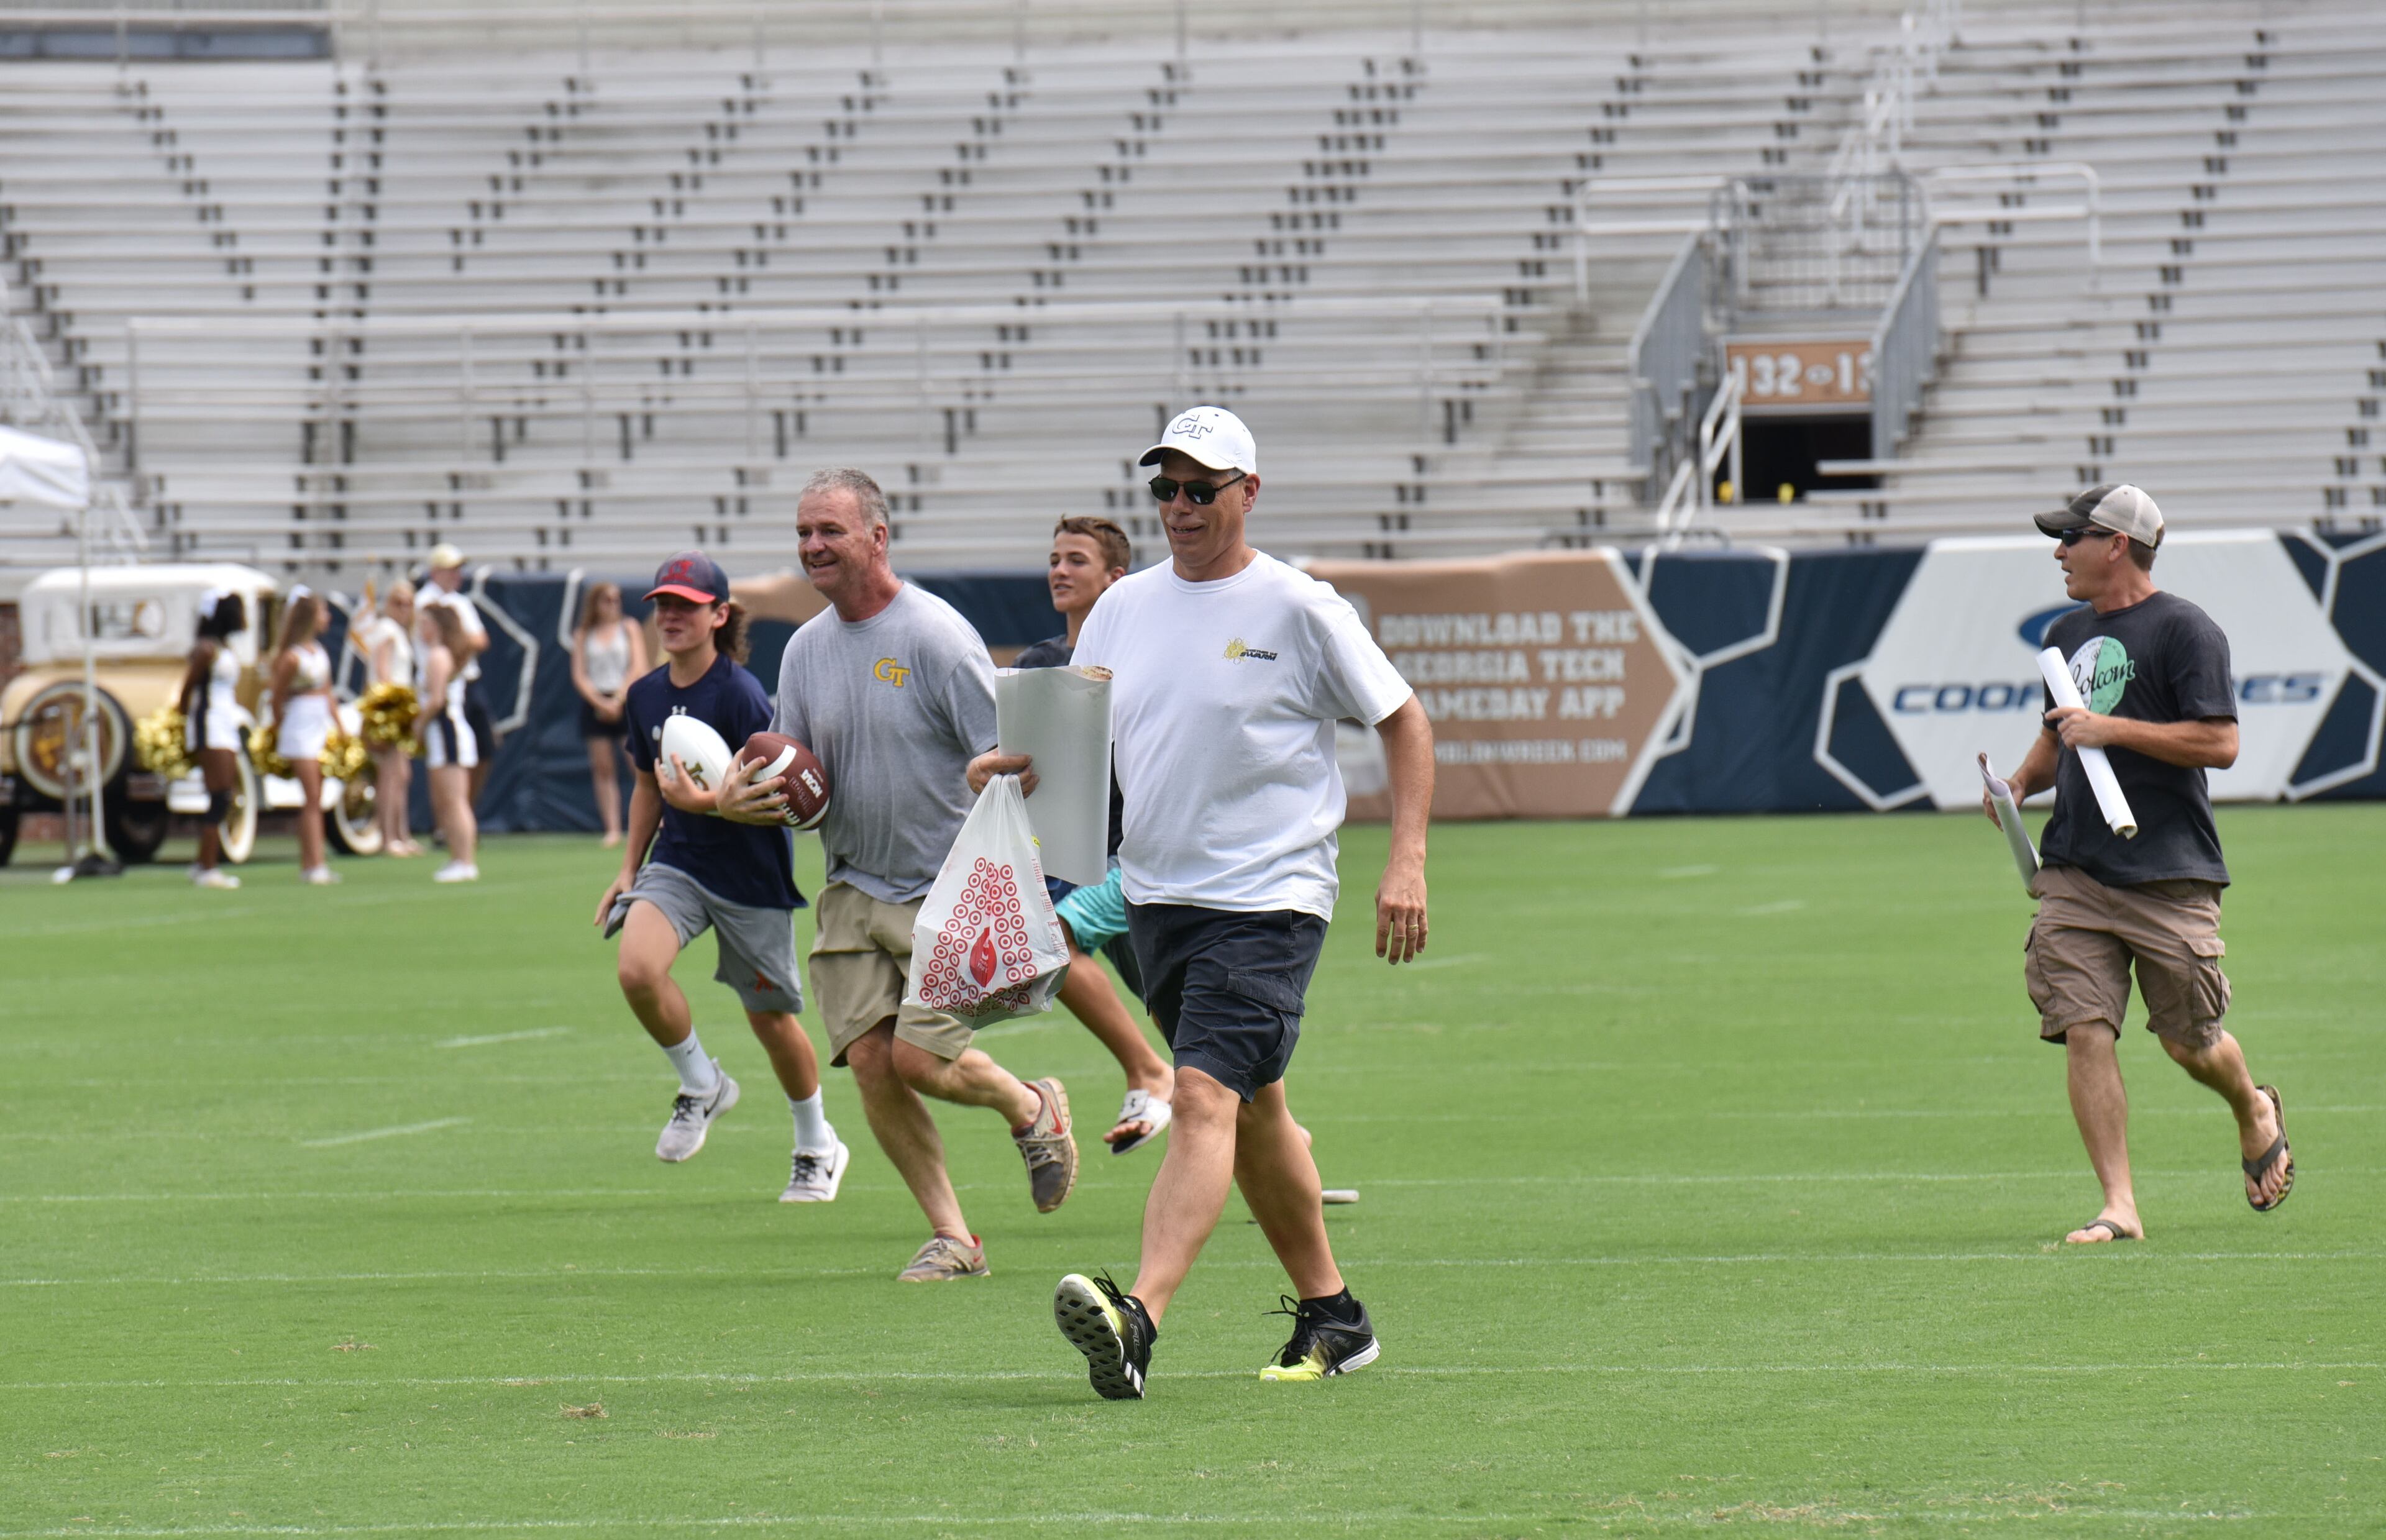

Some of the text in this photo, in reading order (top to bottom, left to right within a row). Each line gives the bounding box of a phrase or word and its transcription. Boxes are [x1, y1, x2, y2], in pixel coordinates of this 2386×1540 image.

[1172, 414, 1214, 439] GT
[1379, 611, 1639, 646] DOWNLOAD THE
[872, 657, 910, 688] GT
[1240, 652, 1278, 661] SWARM
[1394, 648, 1626, 683] GEORGIA TECH
[1420, 685, 1626, 721] AMEDAY APP
[800, 768, 823, 798] NCAA
[1130, 1323, 1141, 1360] FILA
